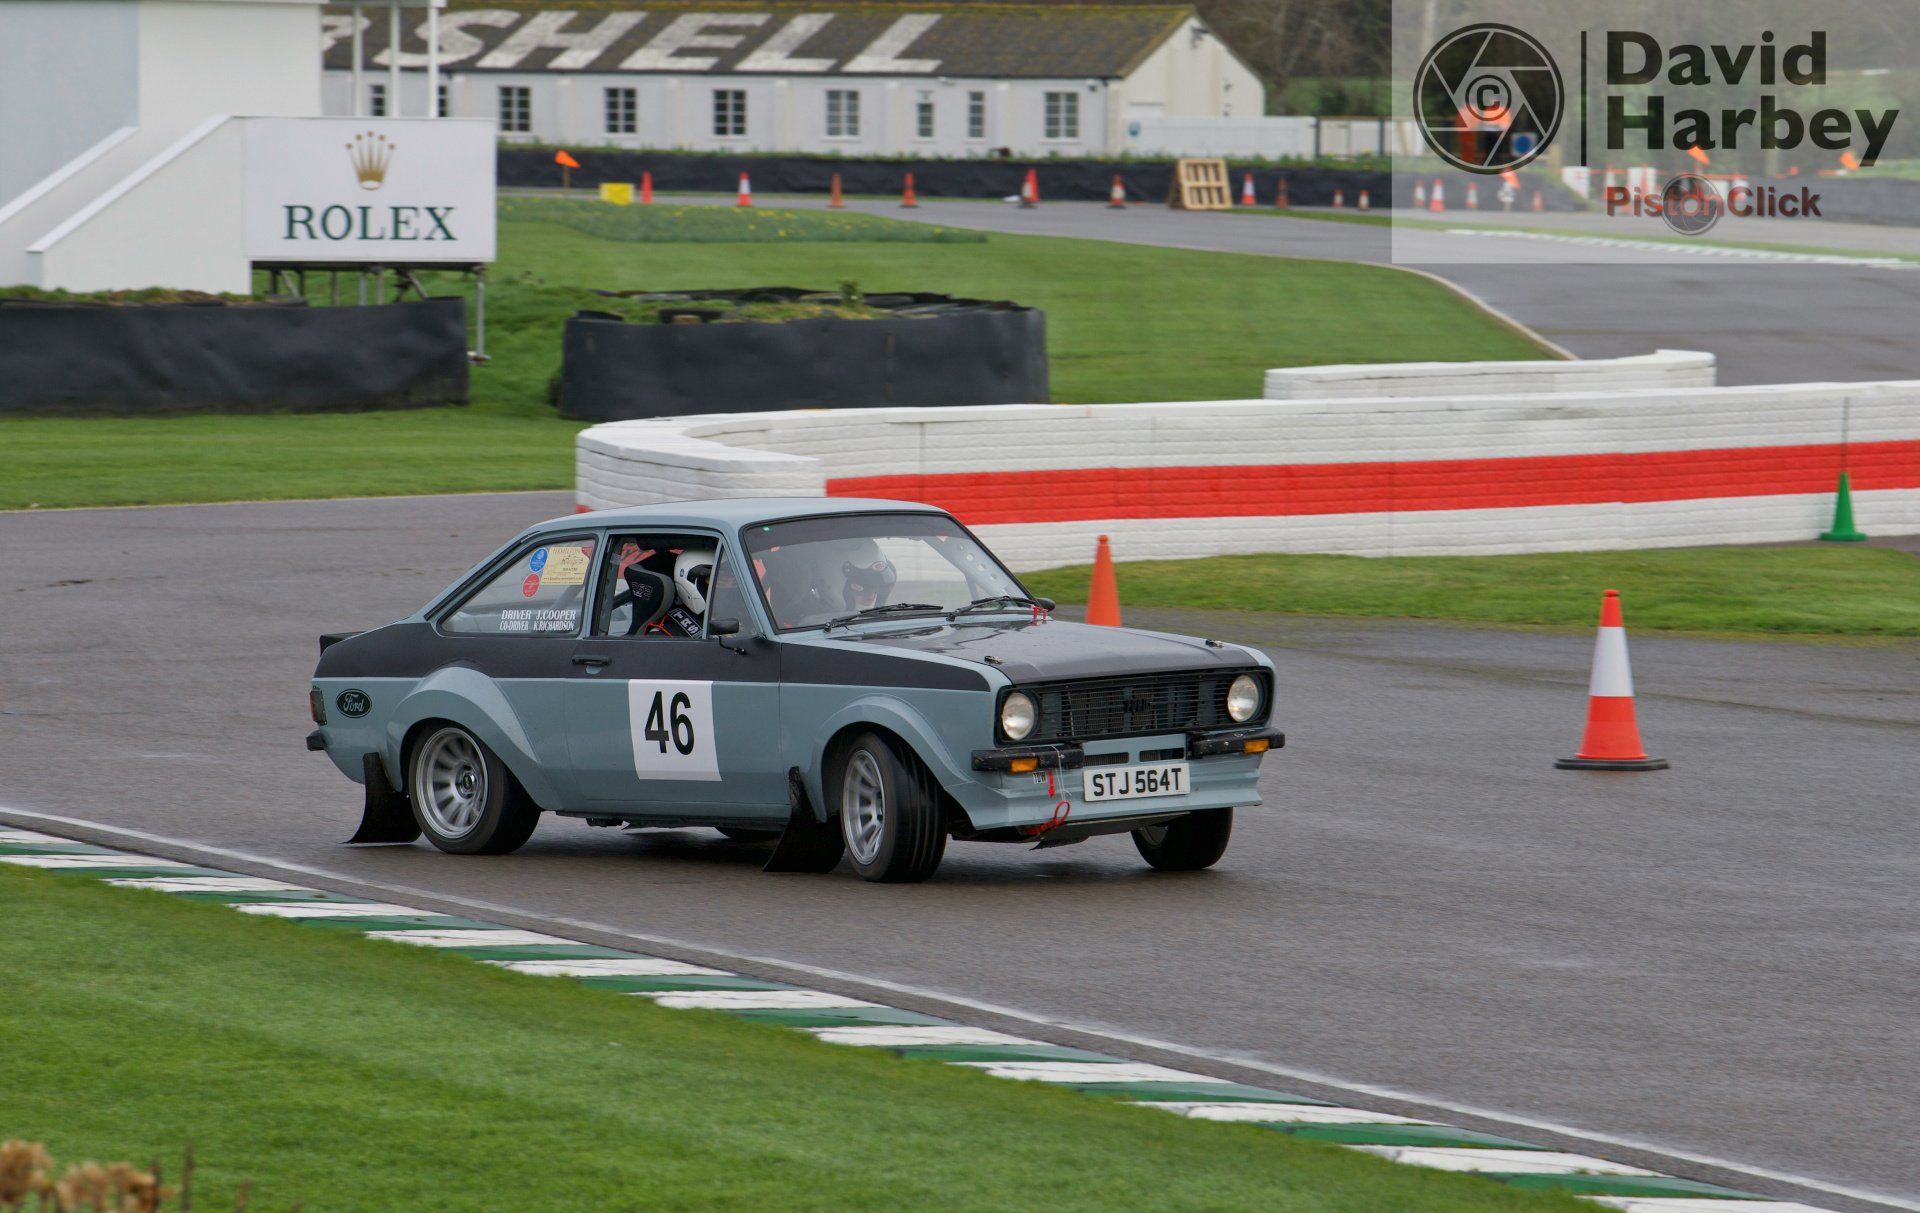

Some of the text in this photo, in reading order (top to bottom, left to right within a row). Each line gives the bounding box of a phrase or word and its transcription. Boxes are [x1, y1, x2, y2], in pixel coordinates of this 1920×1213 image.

[372, 9, 942, 72] SHELL
[282, 204, 458, 241] ROLEX
[500, 620, 530, 631] CO-DRIVER
[501, 610, 577, 620] DRIVER J.COOPER
[343, 693, 365, 712] Ford
[645, 691, 695, 756] 46
[1092, 767, 1182, 798] STJ 564T
